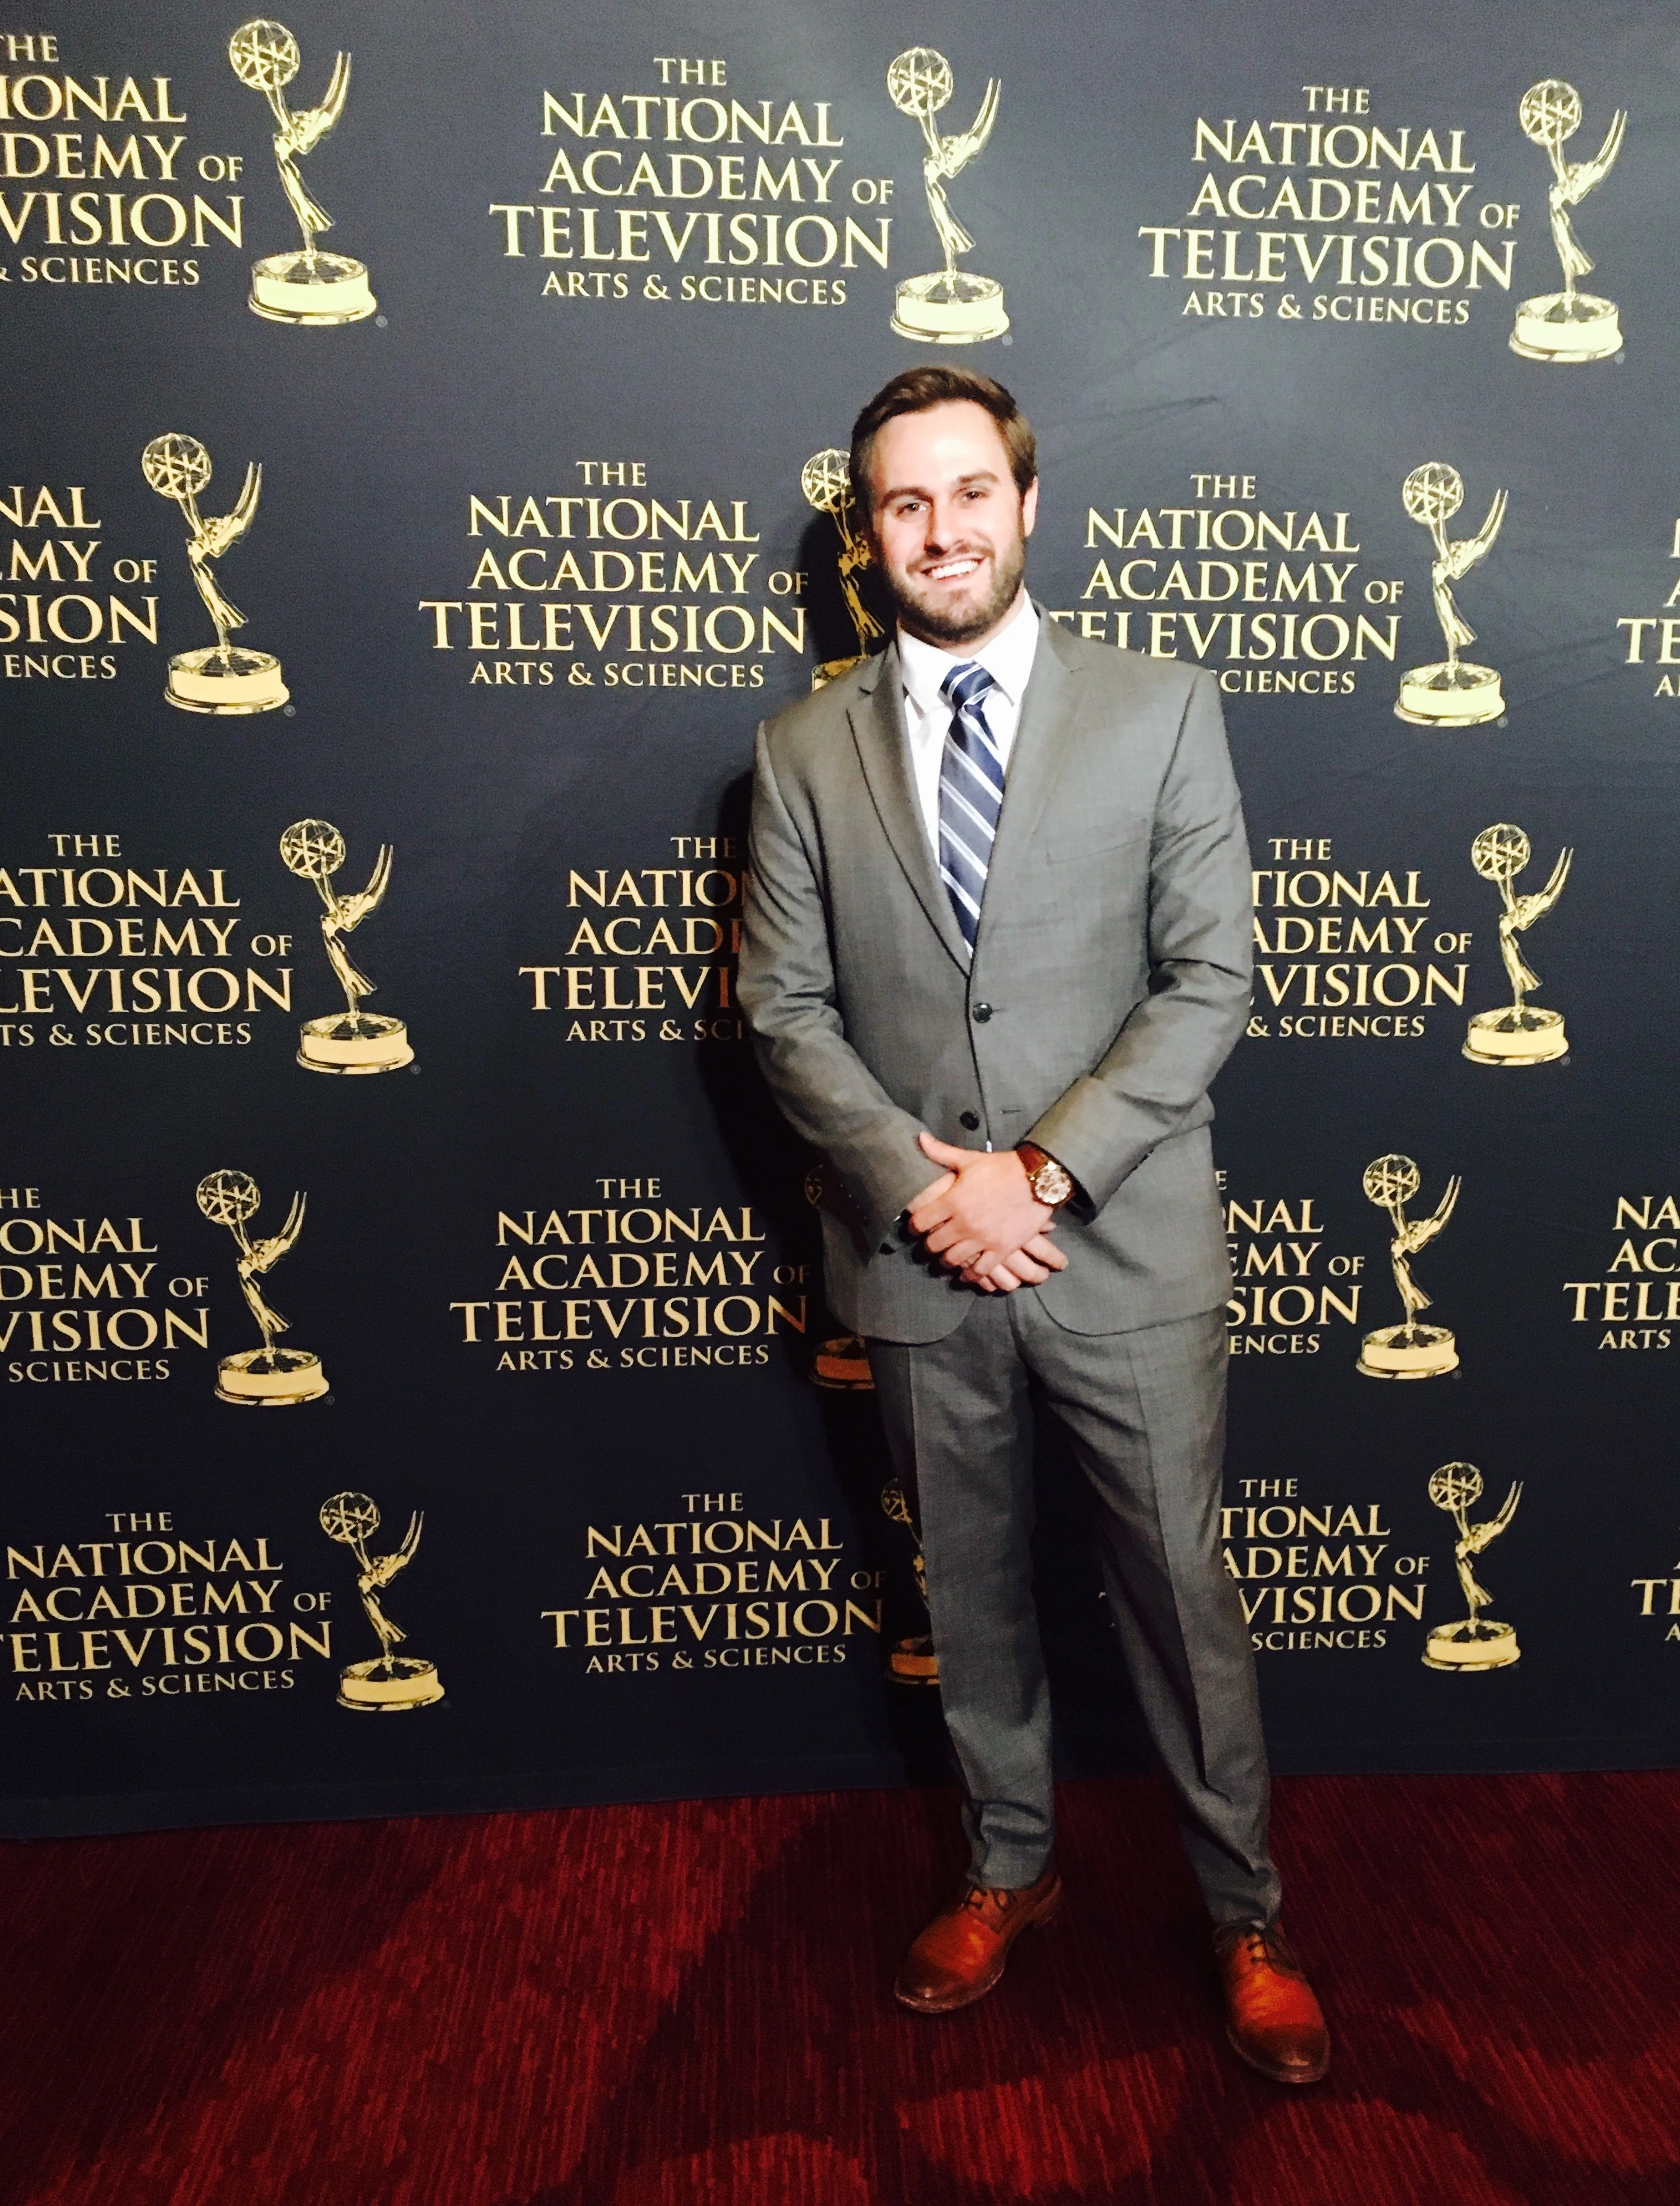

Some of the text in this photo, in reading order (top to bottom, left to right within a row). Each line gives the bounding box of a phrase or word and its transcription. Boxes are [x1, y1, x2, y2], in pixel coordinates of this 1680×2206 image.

[0, 32, 59, 63] HE
[654, 58, 726, 86] THE
[0, 75, 187, 123] IONAL
[1302, 86, 1370, 115] THE
[540, 90, 843, 147] NATIONAL
[1191, 118, 1476, 174] NATIONAL
[197, 155, 243, 183] OF
[540, 149, 894, 204] ACADEMY OF
[1188, 174, 1521, 230] ACADEMY OF
[0, 192, 246, 249] VISION
[489, 204, 893, 269] TELEVISION
[21, 256, 200, 286] SCIENCES
[1138, 227, 1518, 290] TELEVISION
[541, 271, 847, 306] ARTS & SCIENCES
[1182, 291, 1470, 325] ARTS & SCIENCES
[576, 462, 647, 487] THE
[1190, 474, 1256, 500] THE
[467, 495, 760, 542] NATIONAL
[1085, 508, 1360, 552] NATIONAL
[0, 539, 157, 583] MY OF
[468, 548, 809, 595] ACADEMY OF
[1081, 559, 1405, 604] ACADEMY OF
[419, 601, 807, 654] TELEVISION
[469, 662, 764, 688] ARTS & SCIENCES
[49, 834, 122, 857] THE
[670, 837, 737, 859] THE
[1268, 838, 1331, 861] THE
[1251, 870, 1431, 908] TIONAL
[251, 934, 293, 957] OF
[1434, 932, 1473, 954] OF
[1250, 964, 1471, 1008] VISION
[49, 1024, 78, 1046] &
[86, 1023, 252, 1046] SCIENCES
[566, 1020, 646, 1042] ARTS
[660, 1020, 685, 1041] &
[1246, 1015, 1425, 1038] & SCIENCES
[596, 1178, 662, 1199] THE
[496, 1207, 766, 1246] NATIONAL
[1221, 1199, 1324, 1234] NAL
[495, 1251, 810, 1291] ACADEMY OF
[1328, 1256, 1366, 1277] OF
[169, 1277, 209, 1298] OF
[449, 1294, 805, 1343] TELEVISION
[1598, 1329, 1671, 1350] ARTS
[9, 1359, 171, 1382] SCIENCES
[496, 1344, 769, 1371] ARTS & SCIENCES
[682, 1492, 744, 1514] THE
[1239, 1478, 1298, 1498] THE
[106, 1513, 173, 1533] THE
[586, 1518, 843, 1558] NATIONAL
[1221, 1504, 1391, 1540] TIONAL
[7, 1538, 283, 1579] NATIONAL
[1394, 1556, 1430, 1575] OF
[585, 1559, 886, 1599] ACADEMY OF
[10, 1580, 332, 1623] ACADEMY OF
[540, 1600, 880, 1648] TELEVISION
[1251, 1629, 1387, 1651] SCIENCES
[0, 1621, 332, 1673] ELEVISION
[585, 1644, 846, 1673] ARTS & SCIENCES
[15, 1669, 294, 1701] ARTS & SCIENCES
